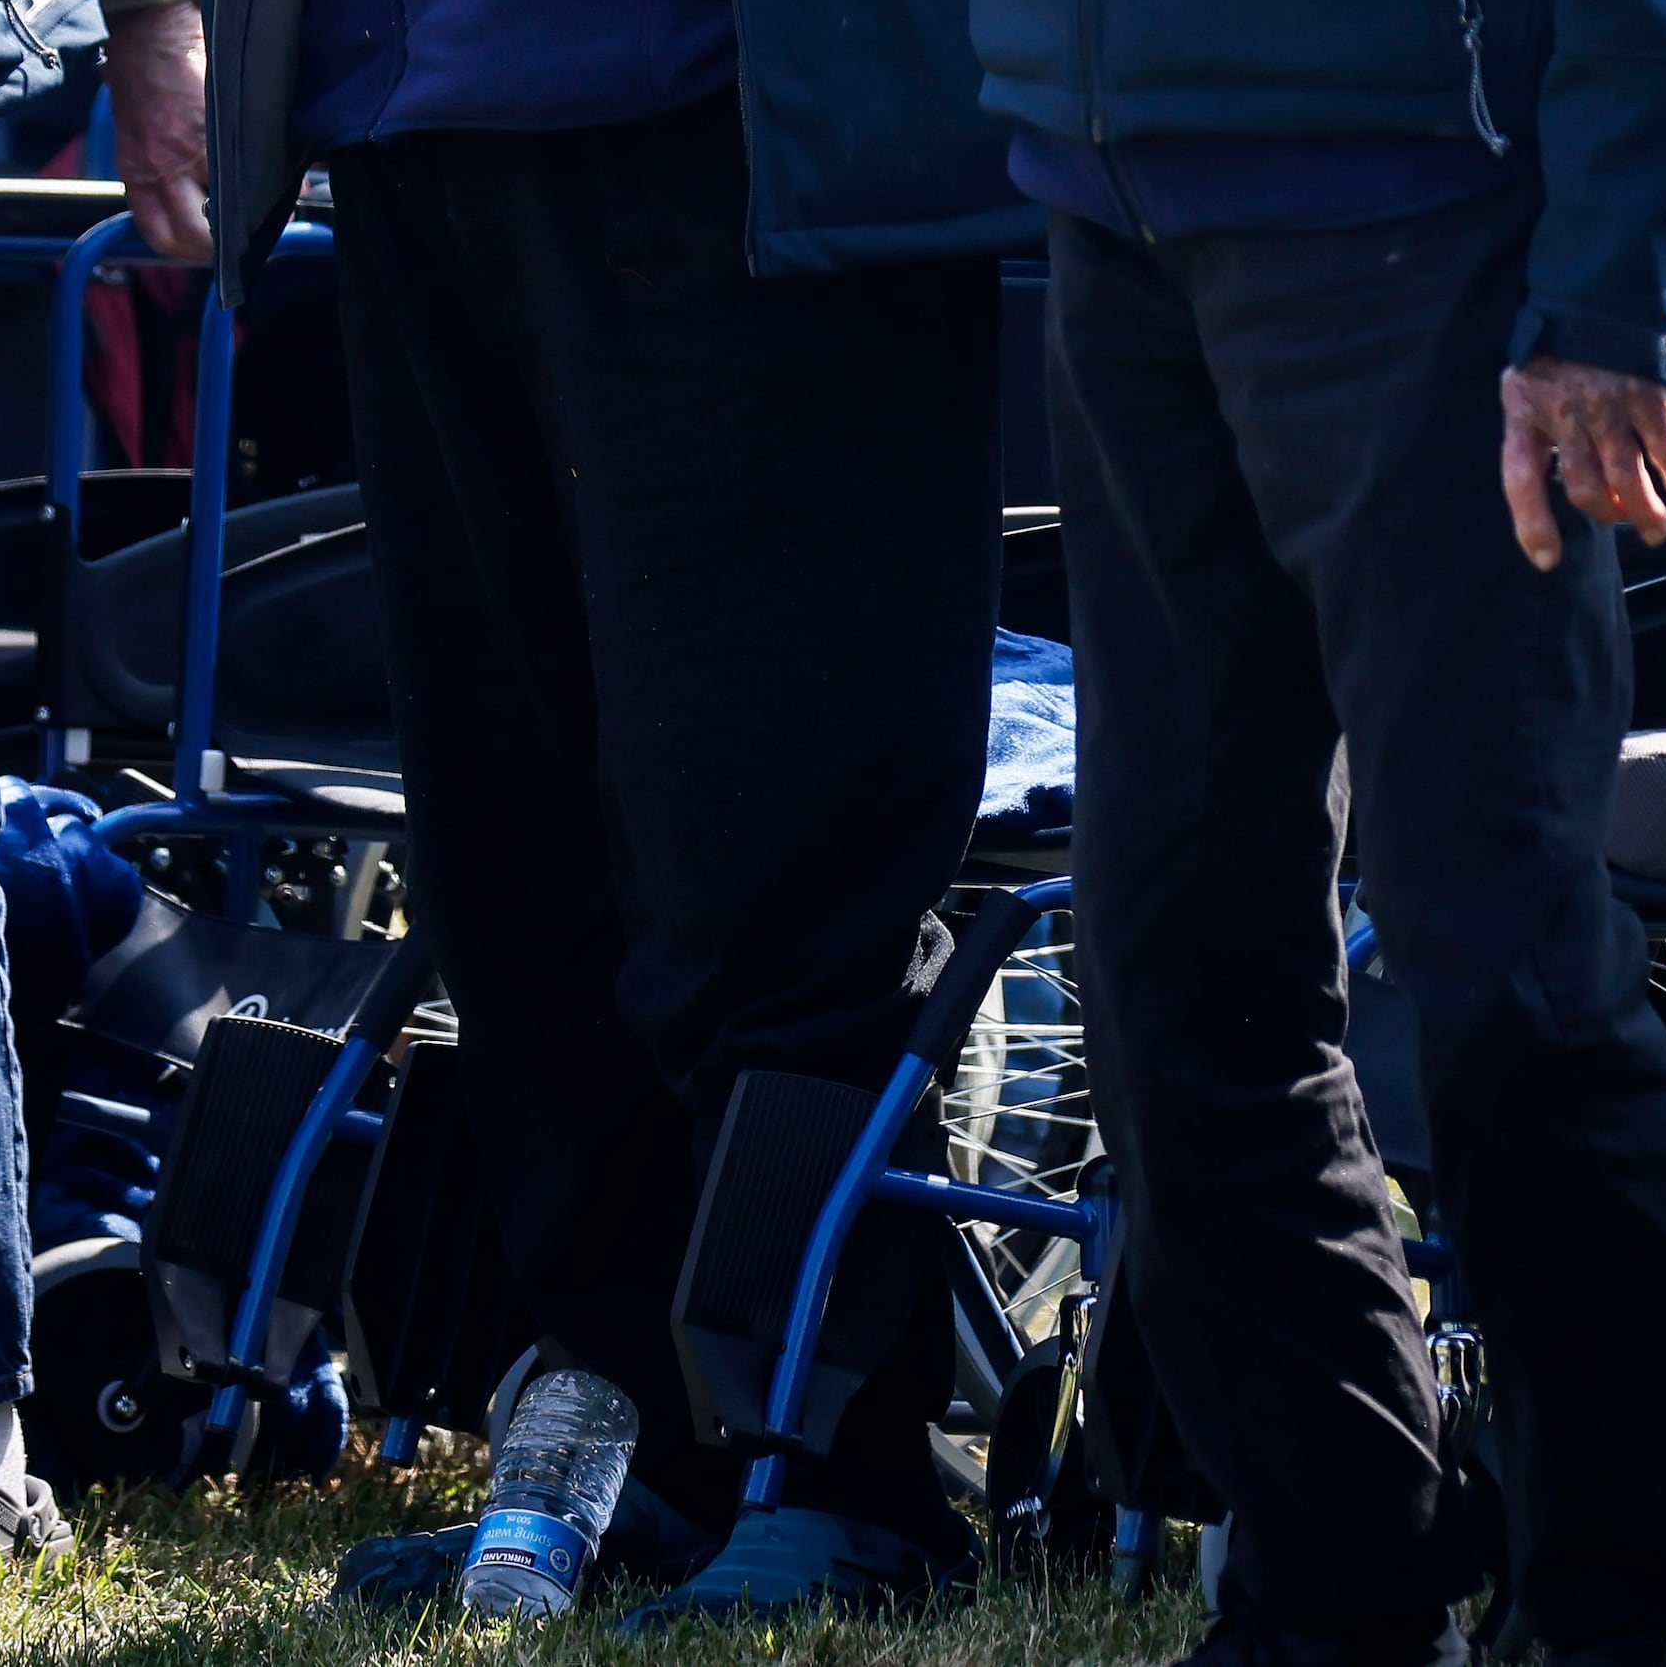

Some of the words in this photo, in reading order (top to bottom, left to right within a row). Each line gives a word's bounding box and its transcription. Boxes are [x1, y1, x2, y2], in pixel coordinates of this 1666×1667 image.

[517, 1515, 532, 1524] 500
[482, 1527, 512, 1540] water
[516, 1526, 553, 1547] spring
[483, 1551, 532, 1566] KIRKLAND
